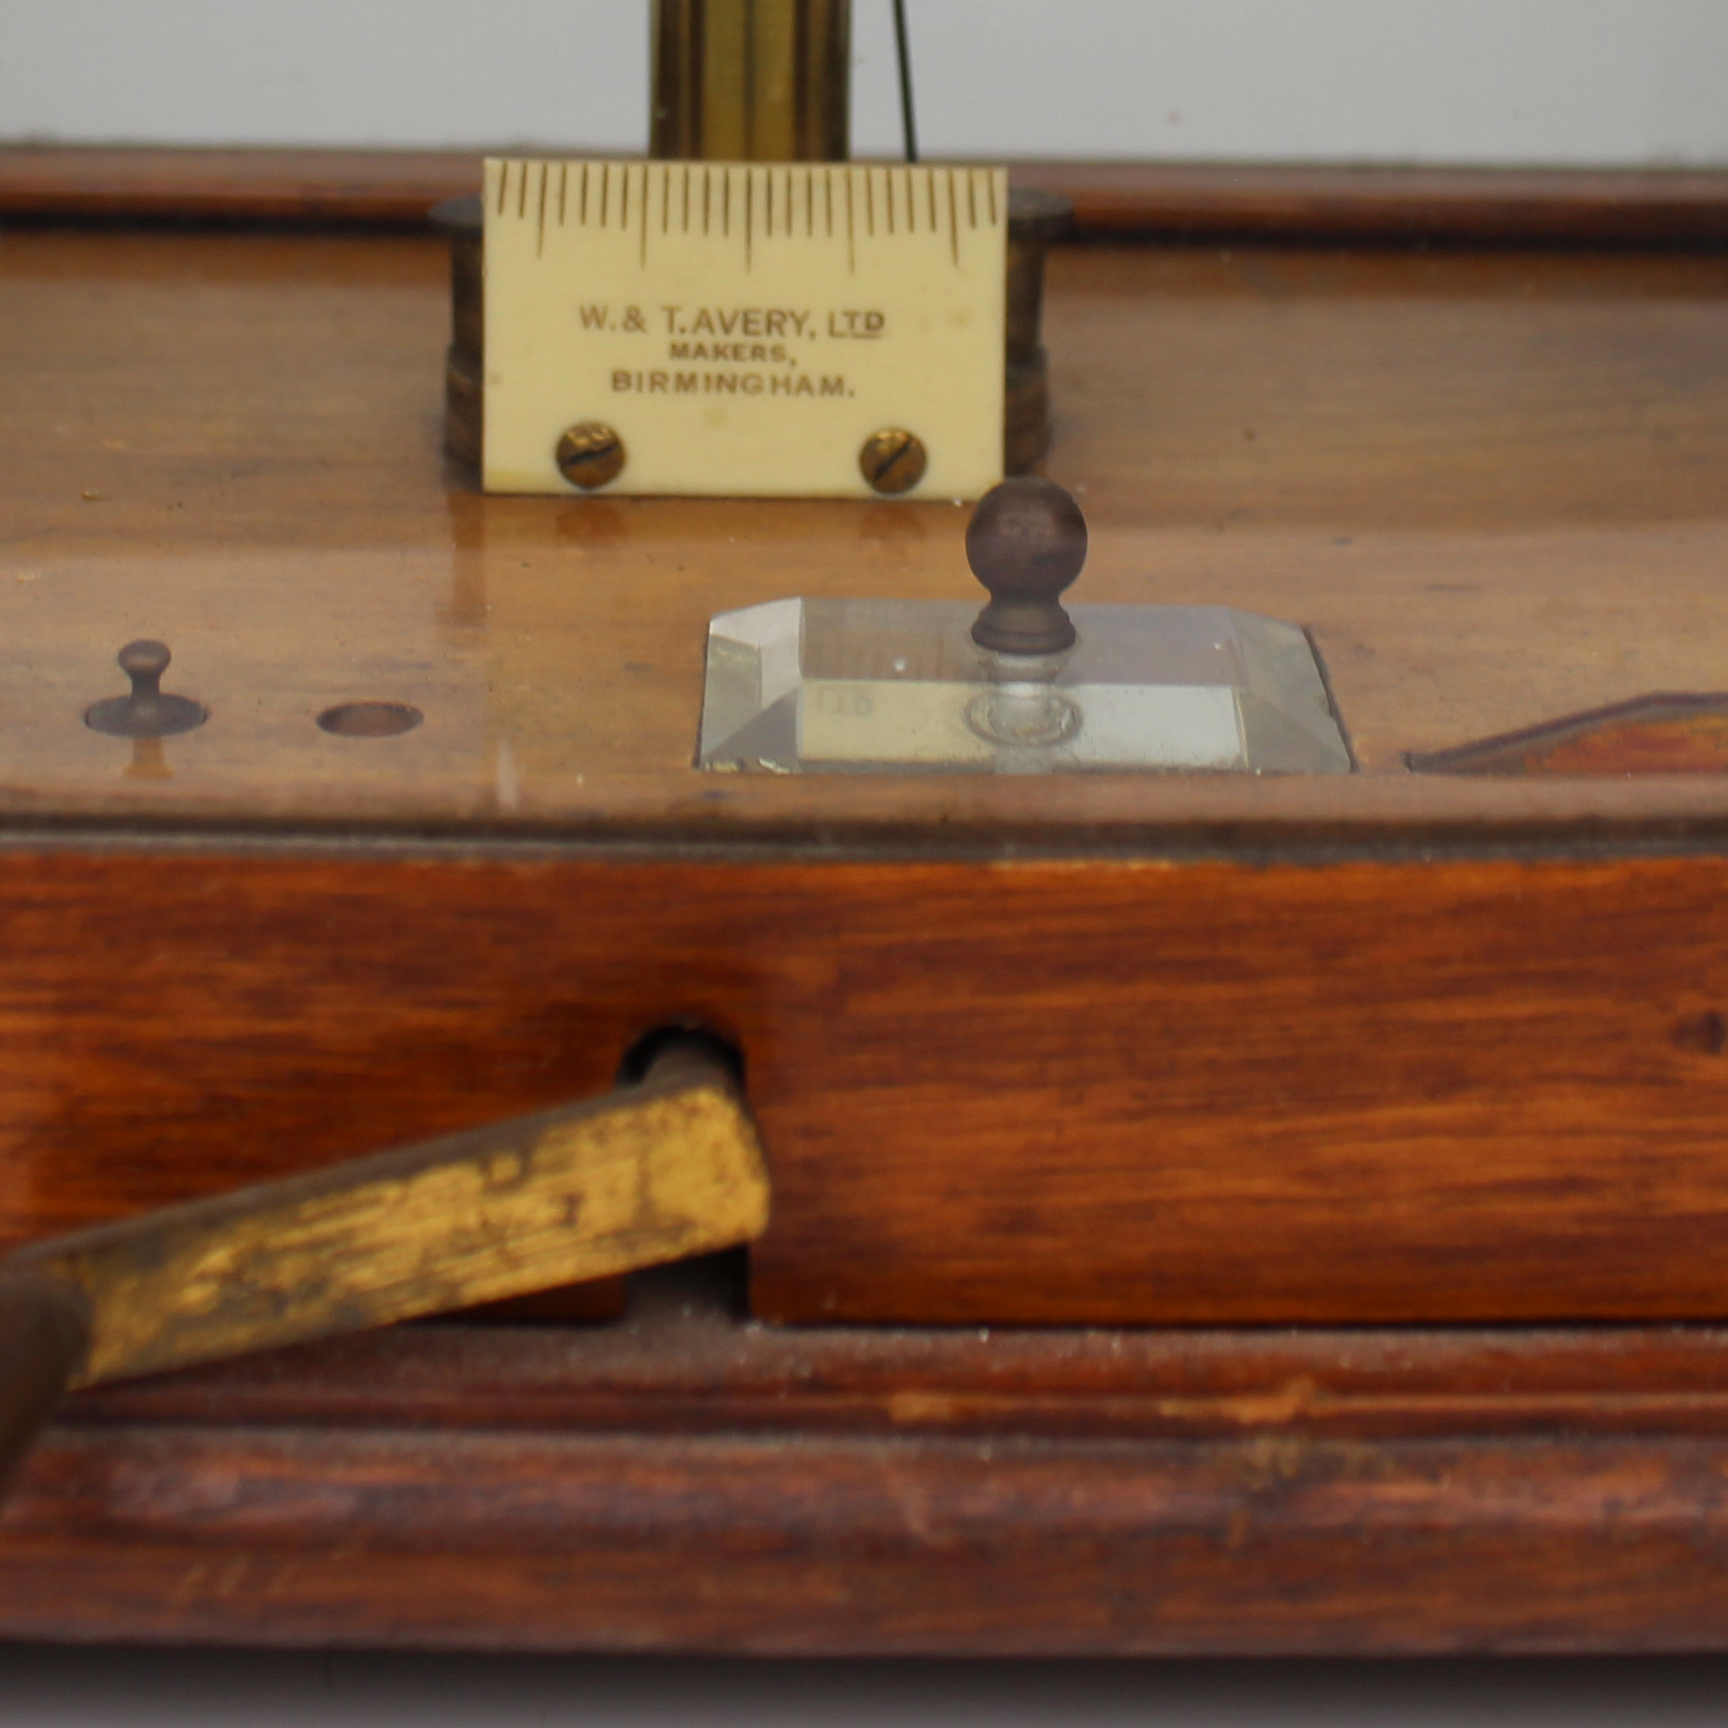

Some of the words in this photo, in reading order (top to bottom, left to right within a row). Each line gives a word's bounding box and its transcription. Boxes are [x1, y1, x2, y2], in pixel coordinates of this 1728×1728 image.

[828, 309, 884, 339] LTD
[670, 342, 797, 367] MAKERS,
[612, 370, 855, 397] BIRMINGHAM.
